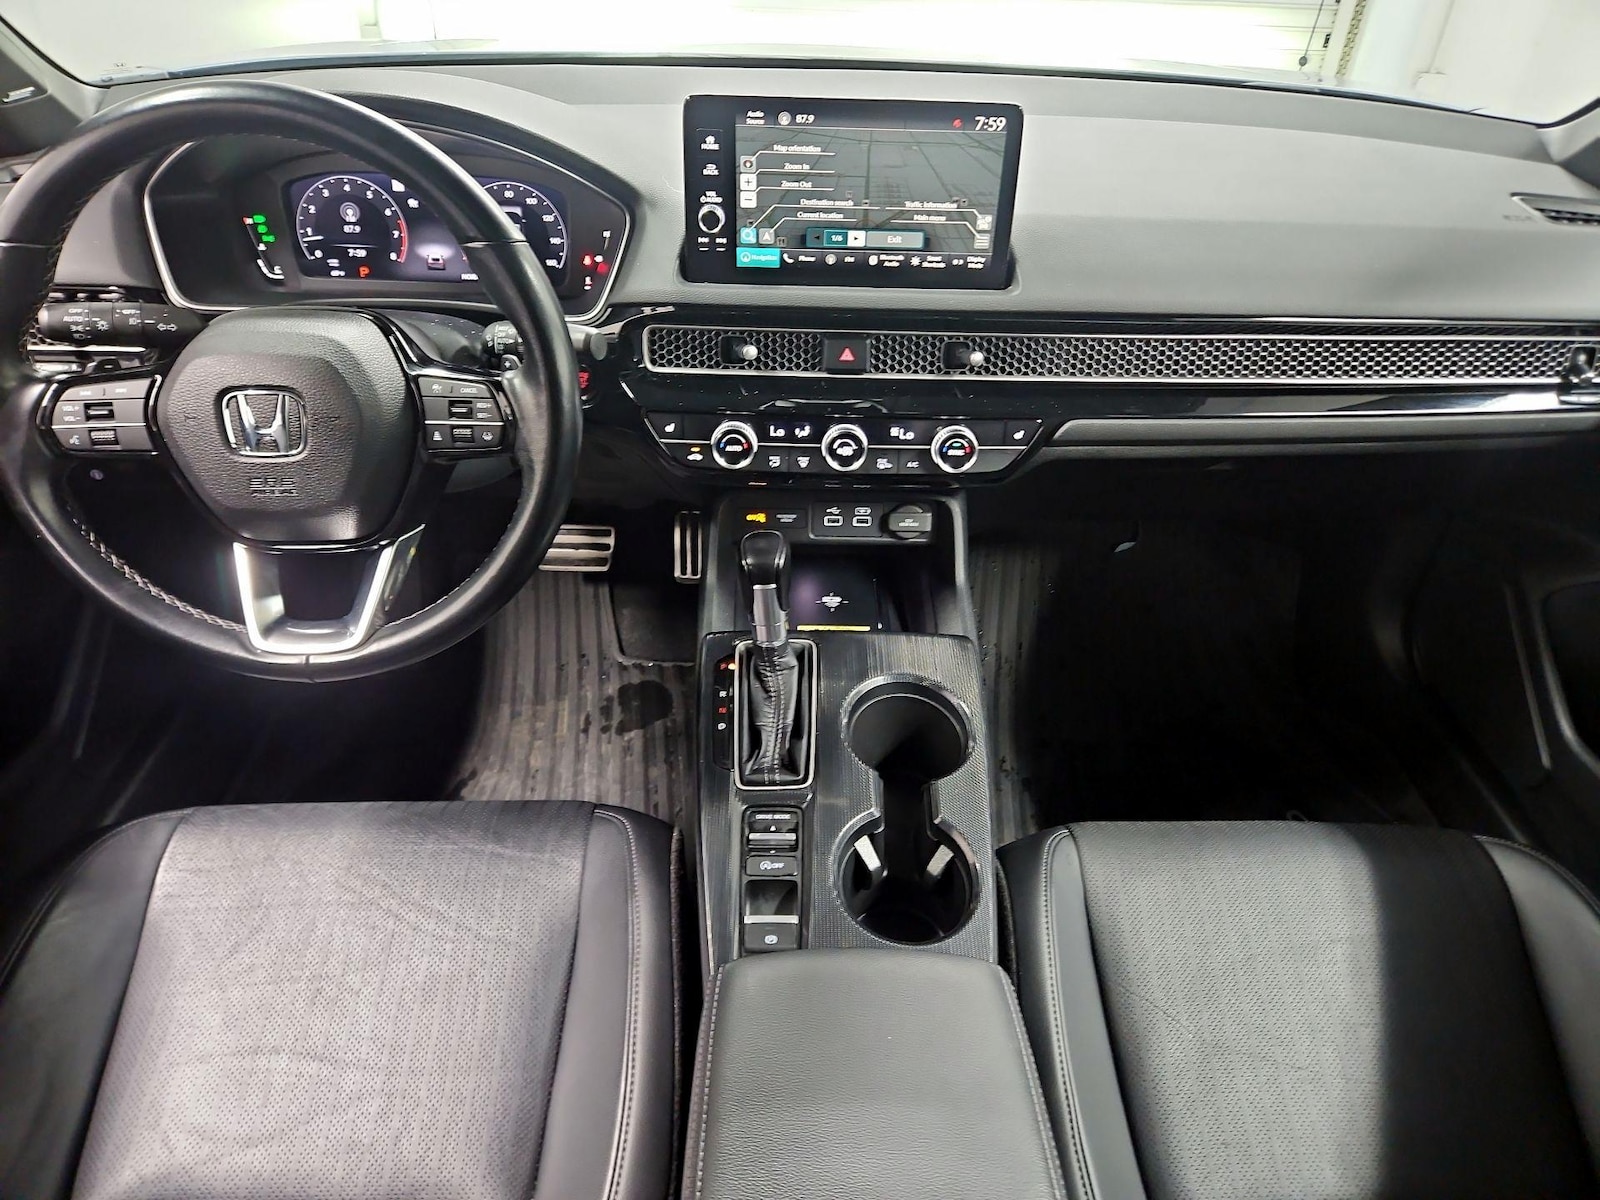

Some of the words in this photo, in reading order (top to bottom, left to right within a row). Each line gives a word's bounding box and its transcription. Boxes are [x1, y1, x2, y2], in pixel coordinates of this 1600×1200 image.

[795, 114, 815, 124] 87.9
[974, 115, 1007, 131] 7:59
[773, 144, 788, 153] Map
[788, 144, 822, 153] orientation
[783, 162, 803, 170] Zoom
[343, 184, 351, 193] 4
[780, 180, 800, 188] Zoom
[799, 180, 813, 189] Out
[321, 189, 330, 198] 3
[366, 191, 373, 199] 5
[504, 190, 515, 198] 80
[525, 197, 538, 205] 100
[800, 198, 832, 207] Destination
[308, 204, 316, 213] 2
[384, 207, 392, 216] 6
[796, 211, 820, 219] Current
[819, 211, 844, 219] location
[886, 234, 903, 244] Exit
[359, 265, 370, 278] P
[62, 315, 84, 323] AUTO
[769, 424, 786, 437] Lo
[898, 427, 915, 440] Lo
